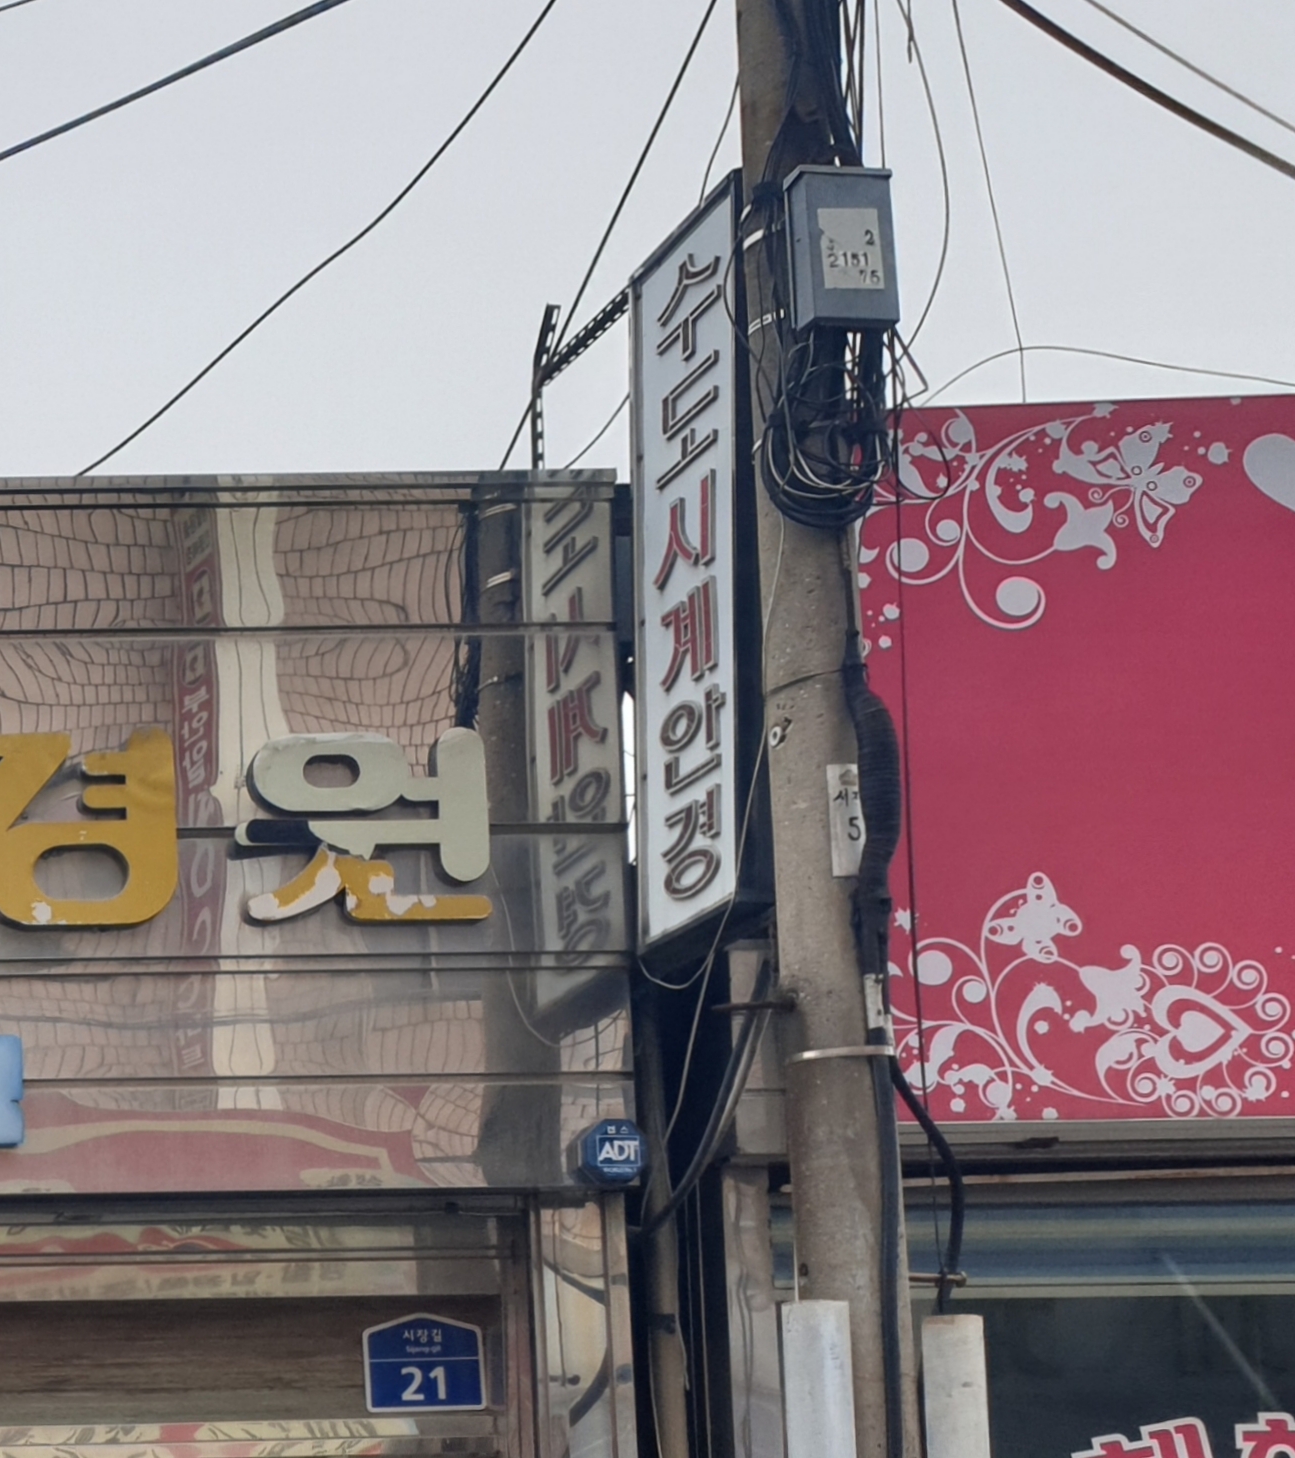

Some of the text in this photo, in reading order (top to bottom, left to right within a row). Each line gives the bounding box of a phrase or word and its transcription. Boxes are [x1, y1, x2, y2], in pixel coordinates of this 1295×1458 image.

[597, 1139, 639, 1162] ADT
[402, 1328, 443, 1343] 시장길
[400, 1365, 447, 1401] 21
